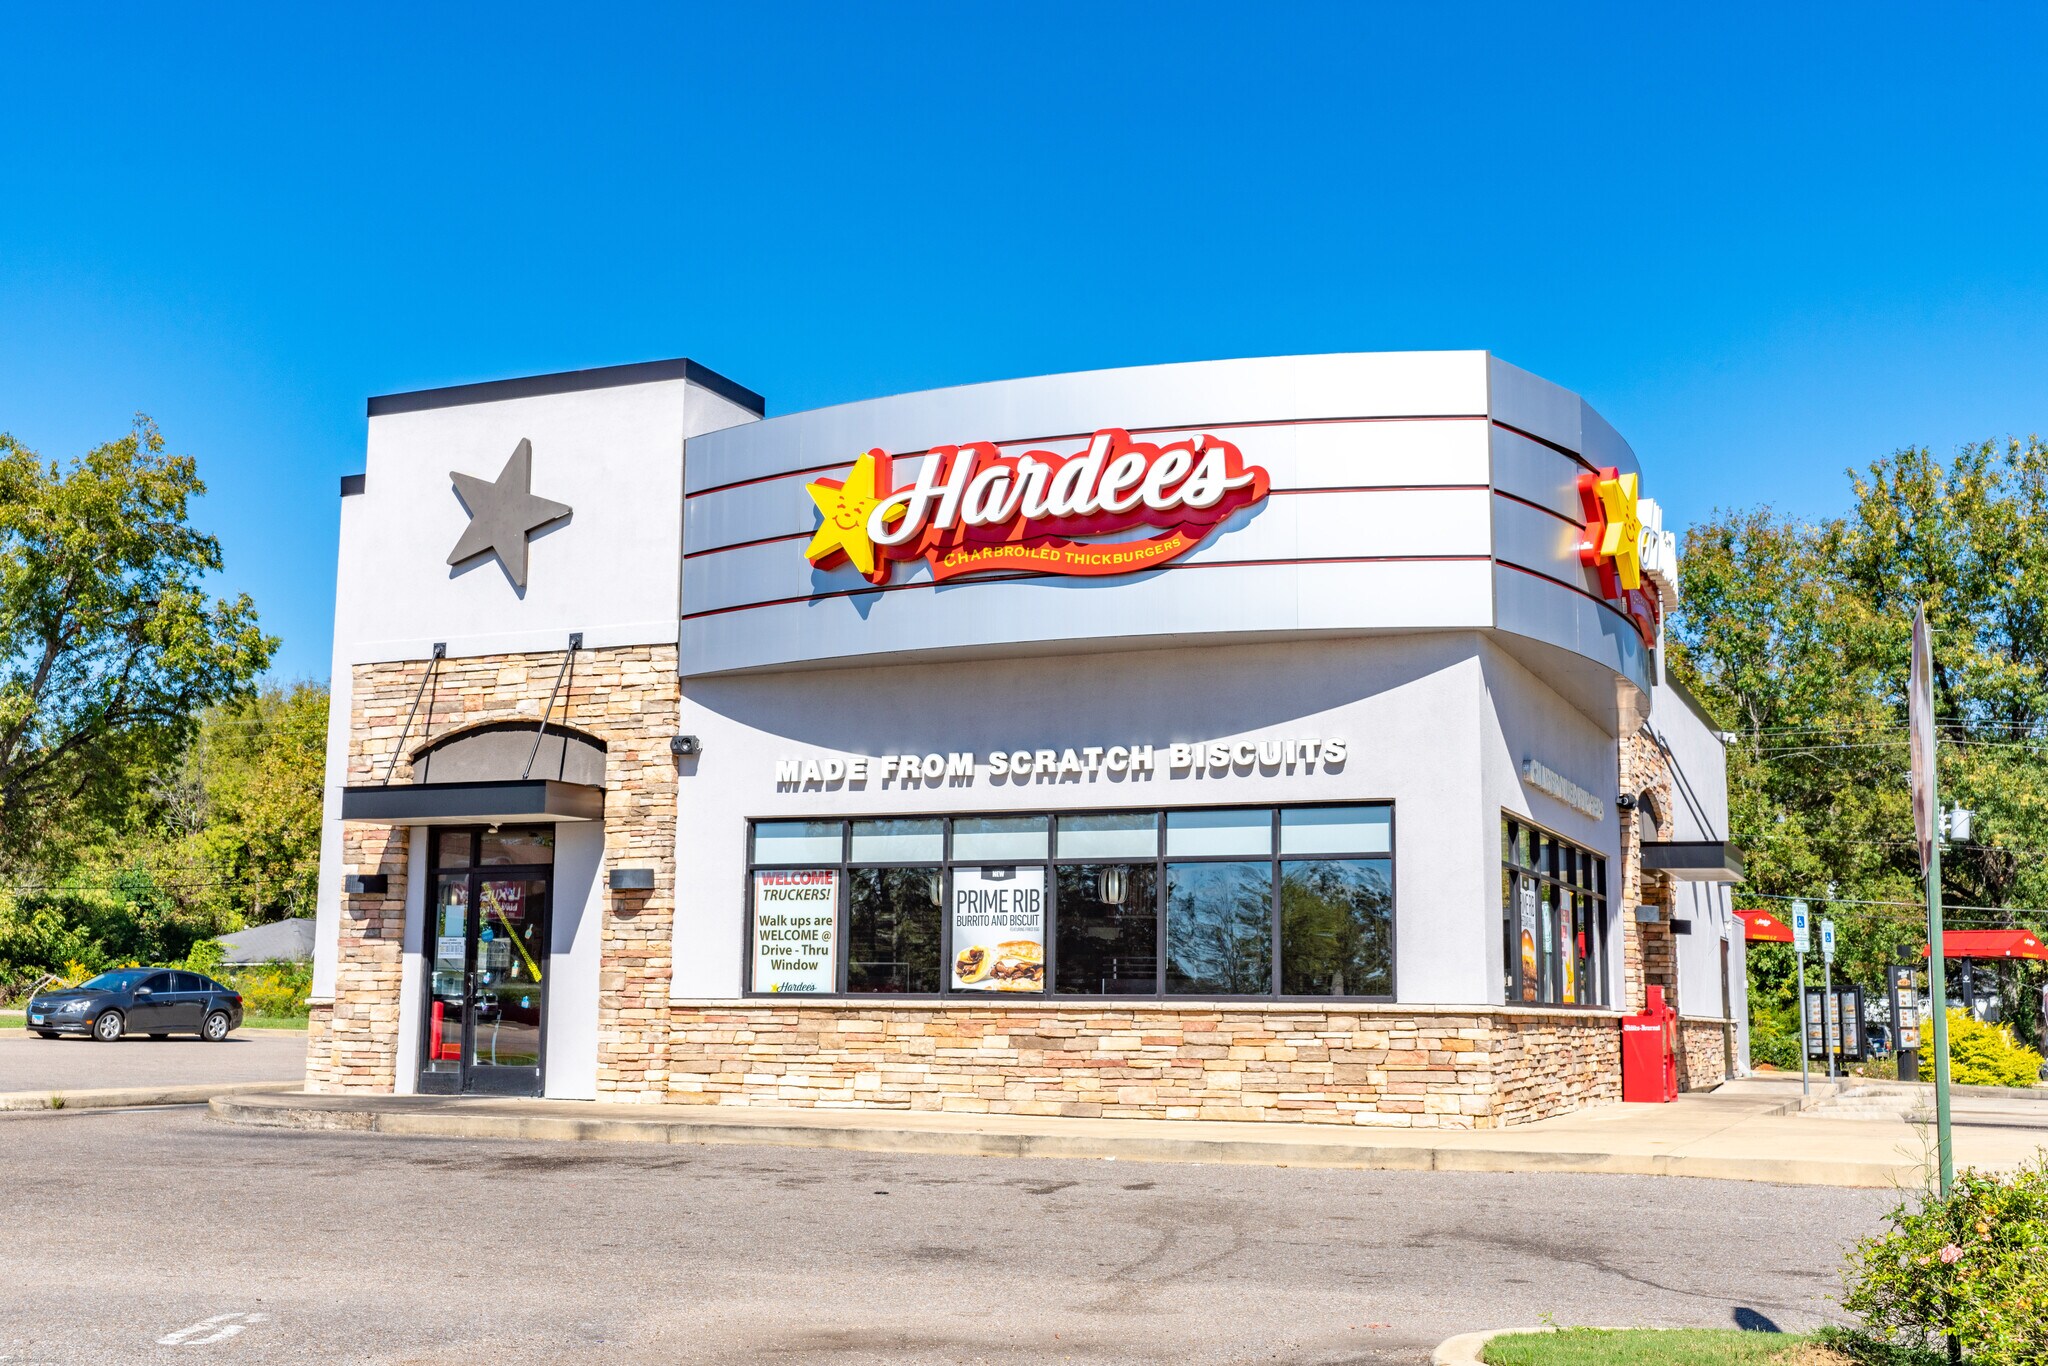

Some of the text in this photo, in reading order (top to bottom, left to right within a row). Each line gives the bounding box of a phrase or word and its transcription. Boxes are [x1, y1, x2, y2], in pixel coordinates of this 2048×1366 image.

[866, 433, 1255, 546] Hardee's
[1064, 537, 1182, 566] THICKBURGERS
[775, 737, 1347, 783] MADE FROM SCRATCH BISCUITS
[761, 871, 833, 886] WELCOME
[992, 870, 1005, 878] NEW
[763, 888, 831, 901] TRUCKERS!
[957, 888, 1040, 914] PRIME RIB
[759, 915, 833, 929] Walk ups are
[956, 914, 1040, 927] BURRITO AND BISCUIT
[759, 929, 832, 942] WELCOME @
[761, 944, 792, 956] Drive
[801, 944, 829, 956] Thru
[771, 958, 819, 971] Window
[776, 981, 817, 992] Hardee's
